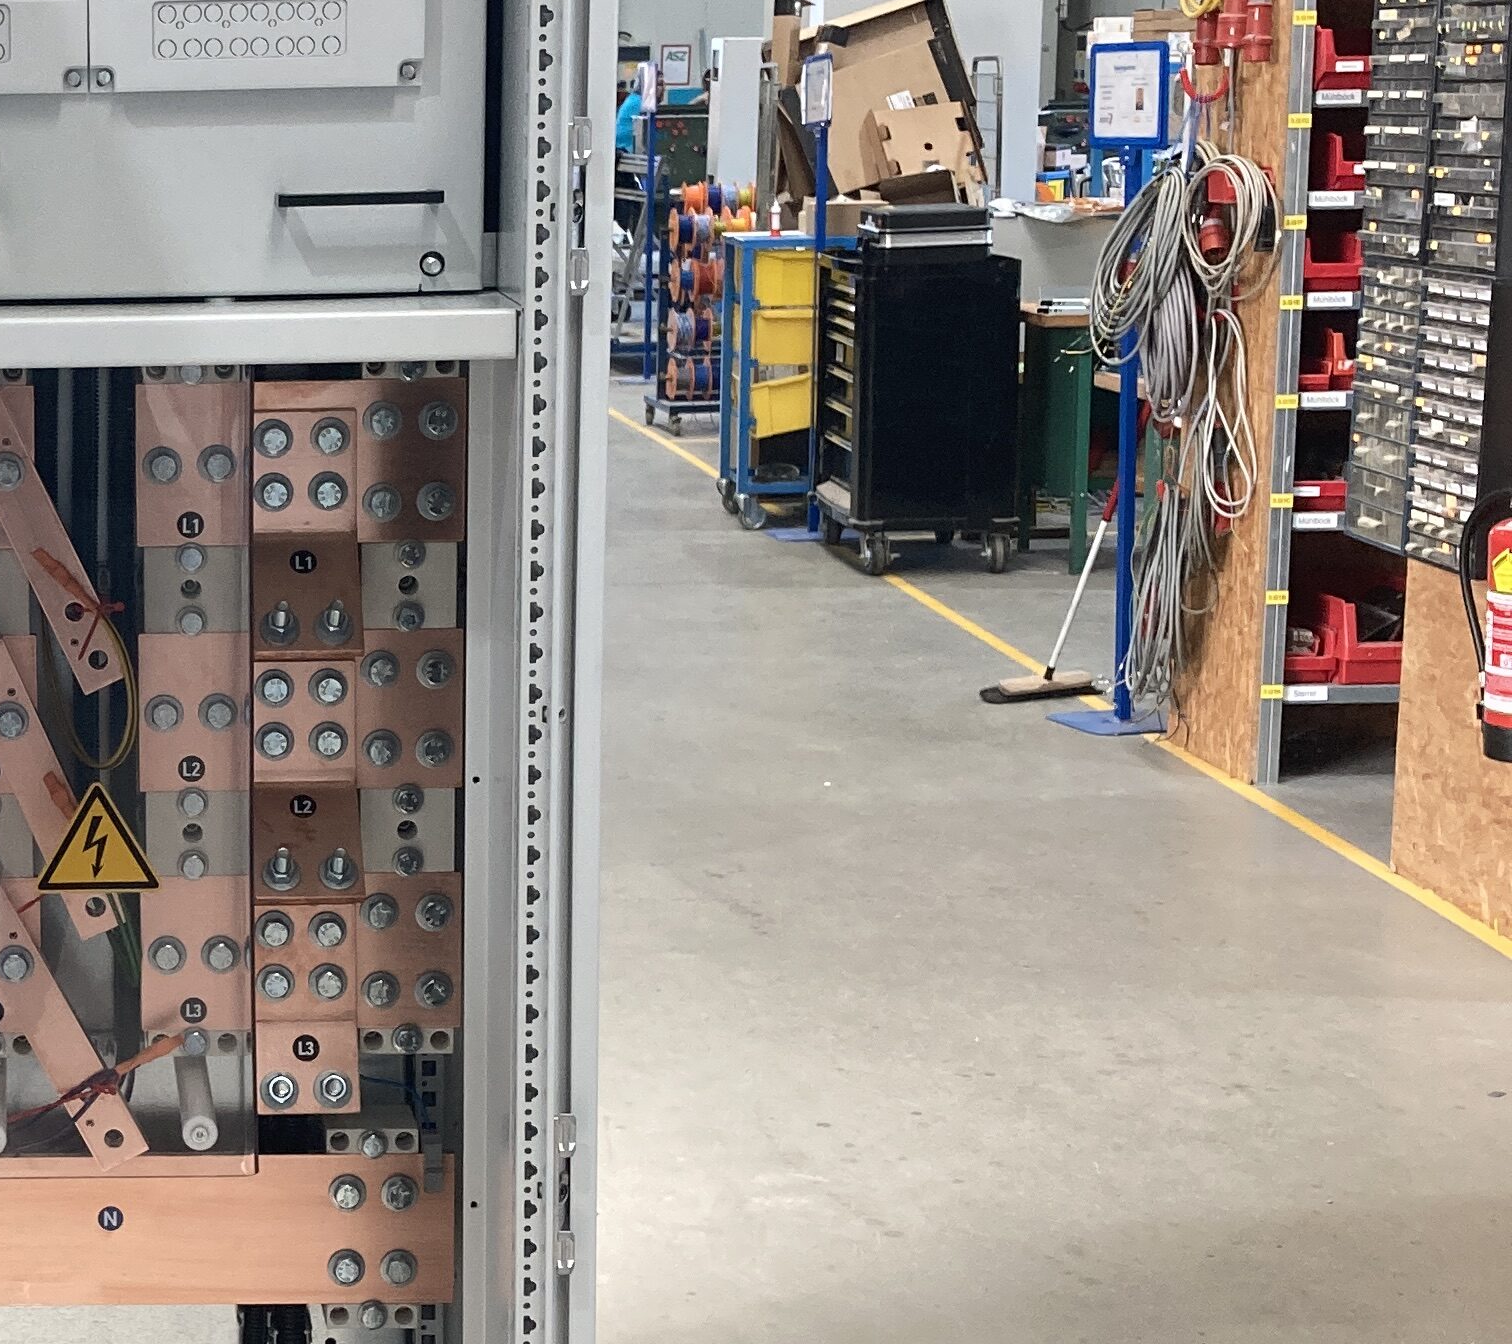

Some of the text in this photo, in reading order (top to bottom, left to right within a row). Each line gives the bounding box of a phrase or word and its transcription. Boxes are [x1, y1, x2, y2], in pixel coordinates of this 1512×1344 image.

[181, 520, 200, 535] L1
[295, 555, 313, 570] L1
[182, 761, 202, 777] L2
[294, 799, 312, 814] L2
[185, 1003, 202, 1018] L3
[298, 1041, 315, 1056] L3
[103, 1210, 118, 1227] N
